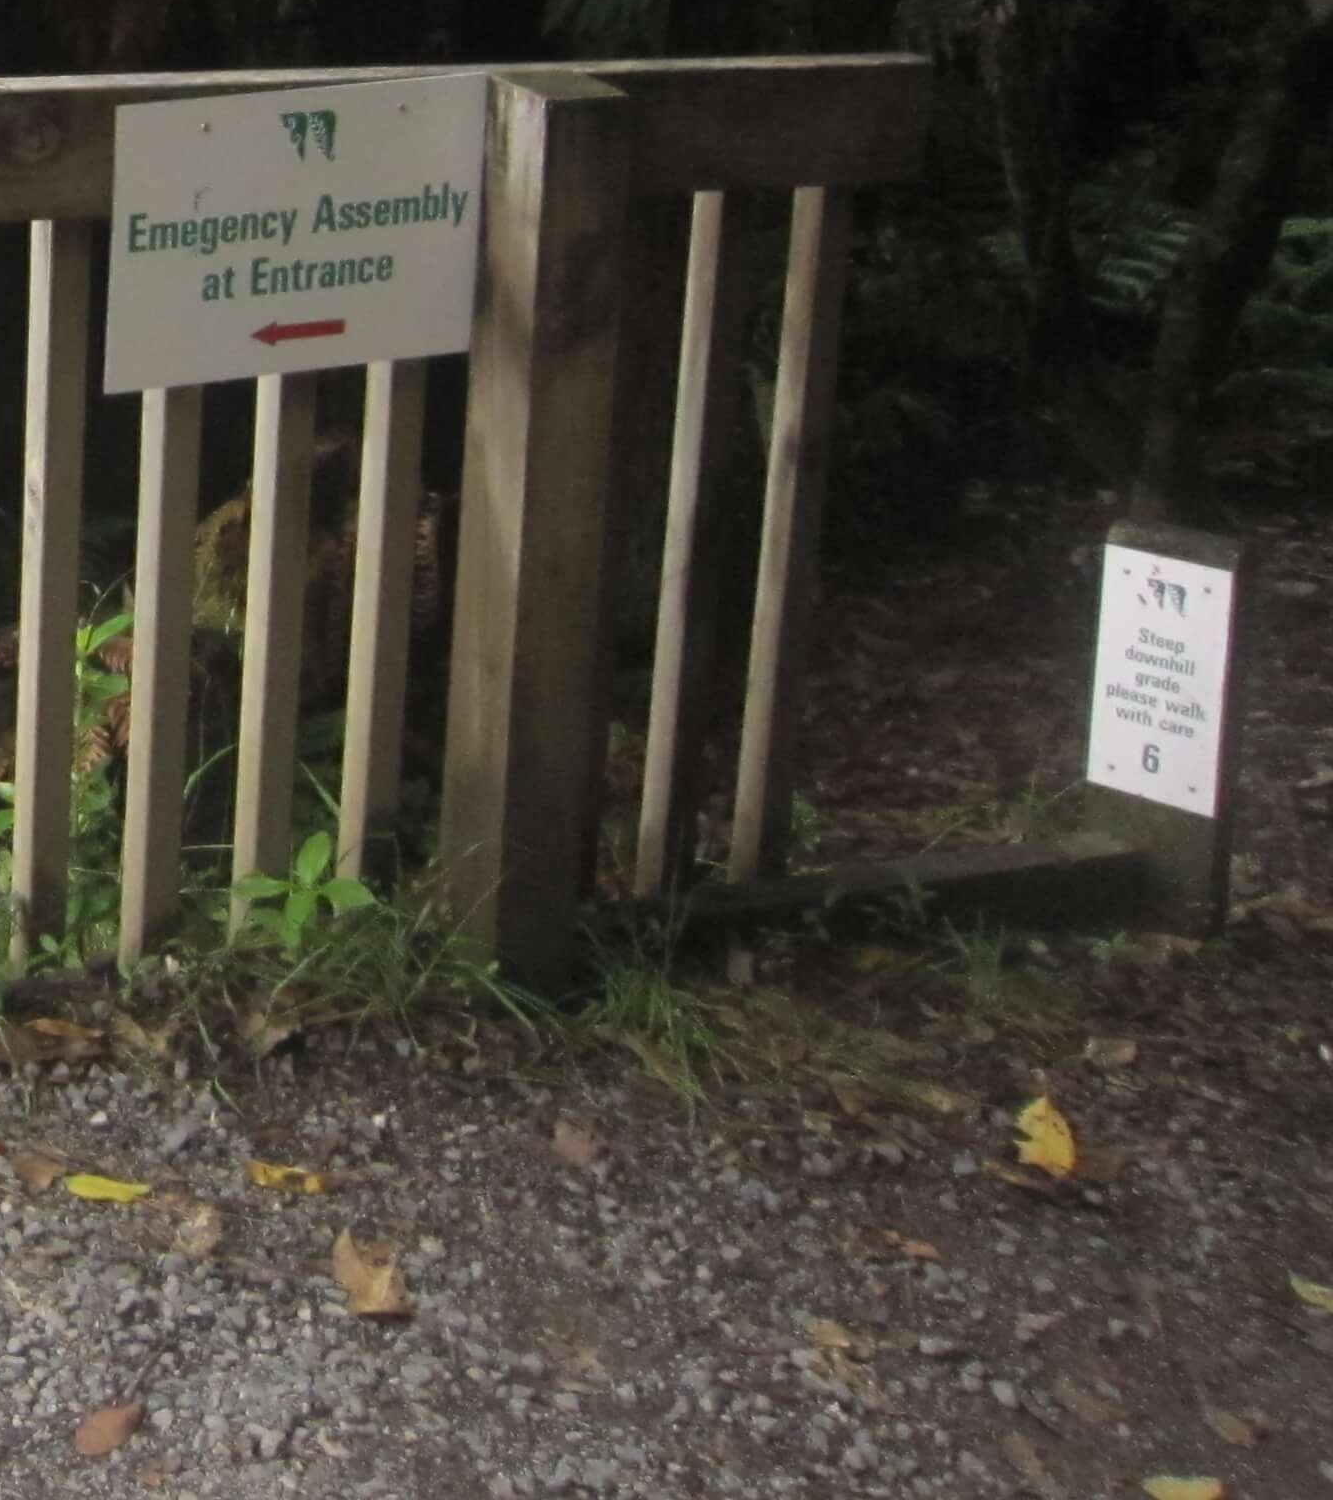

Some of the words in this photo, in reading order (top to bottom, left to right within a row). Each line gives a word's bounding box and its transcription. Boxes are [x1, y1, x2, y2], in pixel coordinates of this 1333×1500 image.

[128, 208, 297, 254] Emegency
[313, 182, 468, 234] Assembly
[202, 271, 234, 301] at
[251, 254, 393, 295] Entrance
[1137, 628, 1185, 654] Steep
[1125, 645, 1196, 677] downhill
[1134, 670, 1180, 694] grade
[1106, 684, 1157, 708] please
[1165, 698, 1207, 722] walk
[1116, 706, 1152, 727] with
[1158, 719, 1194, 739] care
[1141, 744, 1160, 774] 6
